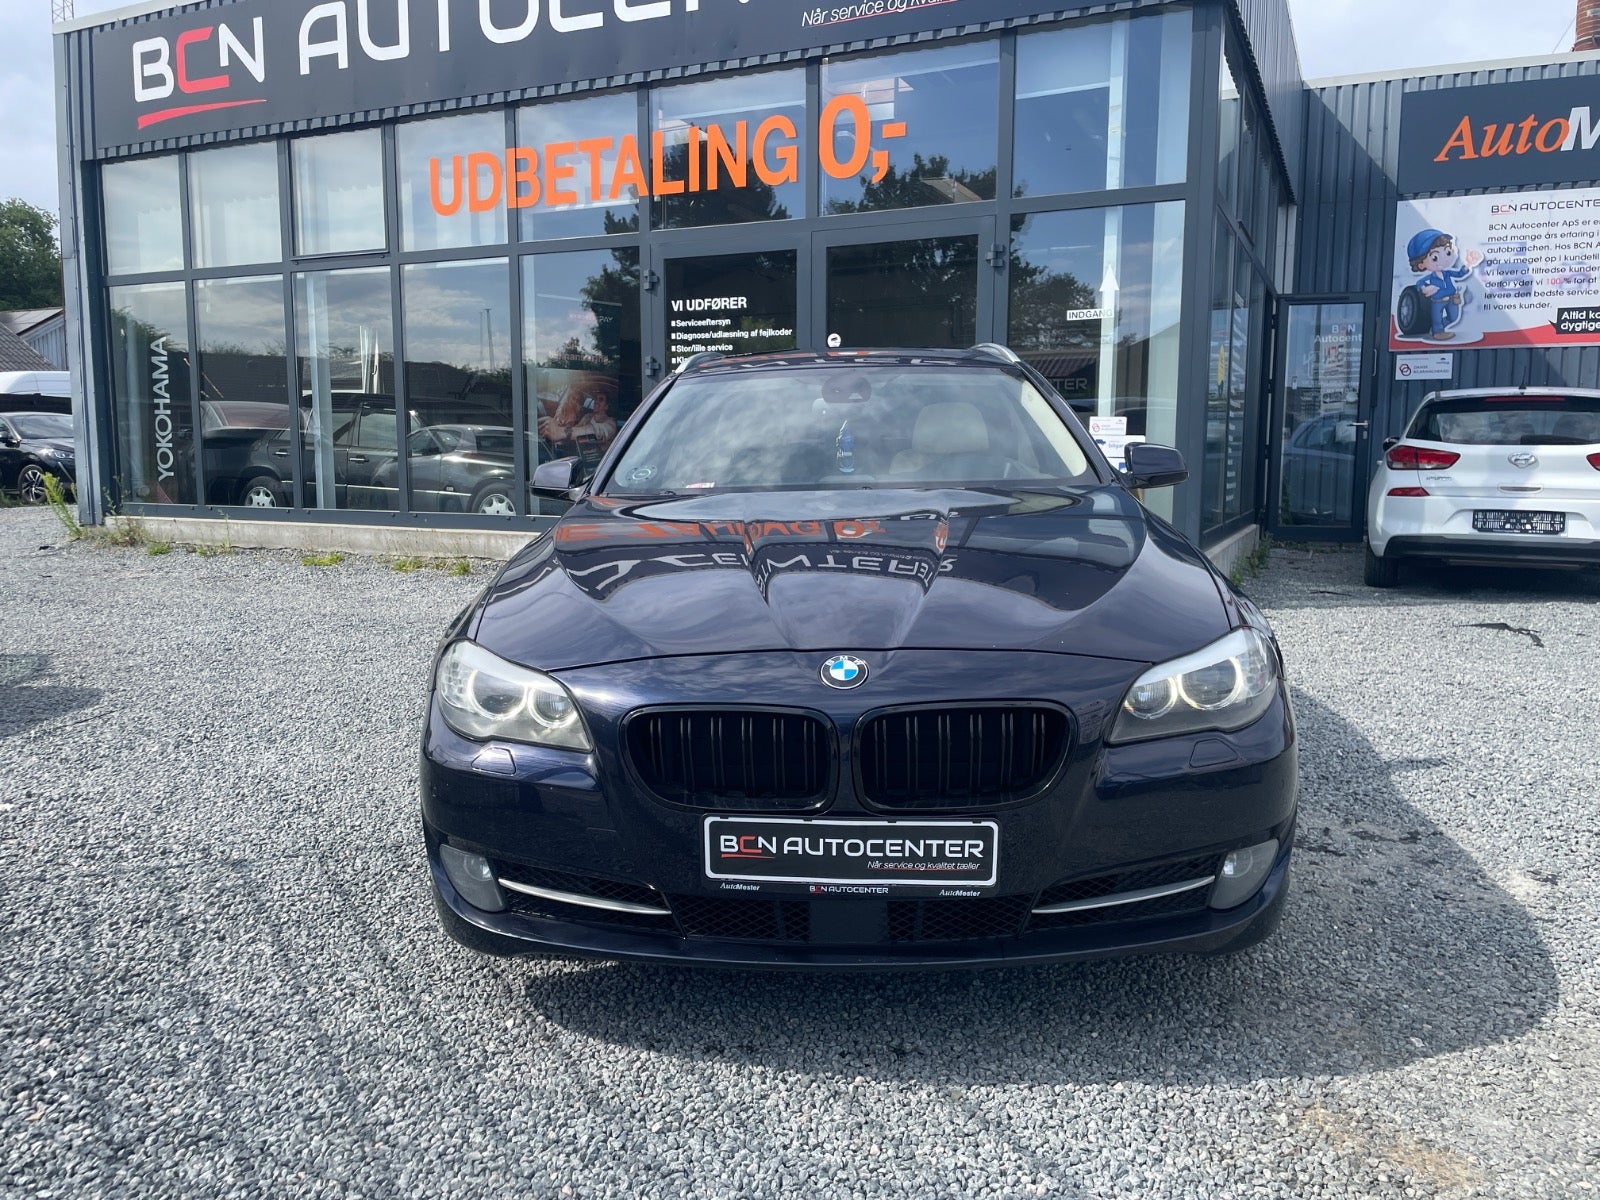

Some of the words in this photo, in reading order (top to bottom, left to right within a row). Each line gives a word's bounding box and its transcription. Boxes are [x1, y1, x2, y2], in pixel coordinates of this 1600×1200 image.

[801, 8, 828, 27] Når
[830, 0, 884, 21] service
[133, 16, 265, 102] BCN
[429, 115, 798, 217] UDBETALING
[818, 94, 907, 184] 0,-
[1491, 204, 1518, 213] BCN
[1488, 223, 1508, 231] BCN
[1510, 221, 1559, 230] Autocenter
[1562, 219, 1580, 228] ApS
[1511, 234, 1542, 242] mange
[1560, 231, 1595, 239] erfaring
[1486, 244, 1552, 254] autobranchen.
[1486, 258, 1501, 267] går
[1513, 256, 1543, 265] meget
[1513, 280, 1533, 288] yder
[1566, 288, 1599, 296] service
[672, 300, 683, 311] VI
[686, 296, 747, 311] UDFØRER
[1068, 309, 1113, 320] INDGANG
[1561, 311, 1586, 320] Altid
[676, 319, 731, 328] Serviceeftersyn
[676, 330, 749, 341] Diagnose/udlæsning
[750, 329, 759, 338] af
[759, 328, 793, 338] fejlkoder
[707, 344, 733, 352] service
[1049, 378, 1088, 390] TER
[150, 336, 175, 482] YOKOHAMA
[720, 834, 777, 854] BCN
[783, 837, 984, 858] AUTOCENTER
[867, 860, 881, 869] Når
[883, 860, 914, 869] service
[914, 862, 927, 870] og
[927, 861, 956, 869] kvalitet
[956, 862, 981, 870] tæller
[720, 882, 760, 891] AutoMester
[828, 886, 889, 894] AUTOCENTER
[939, 889, 981, 897] AutoMester
